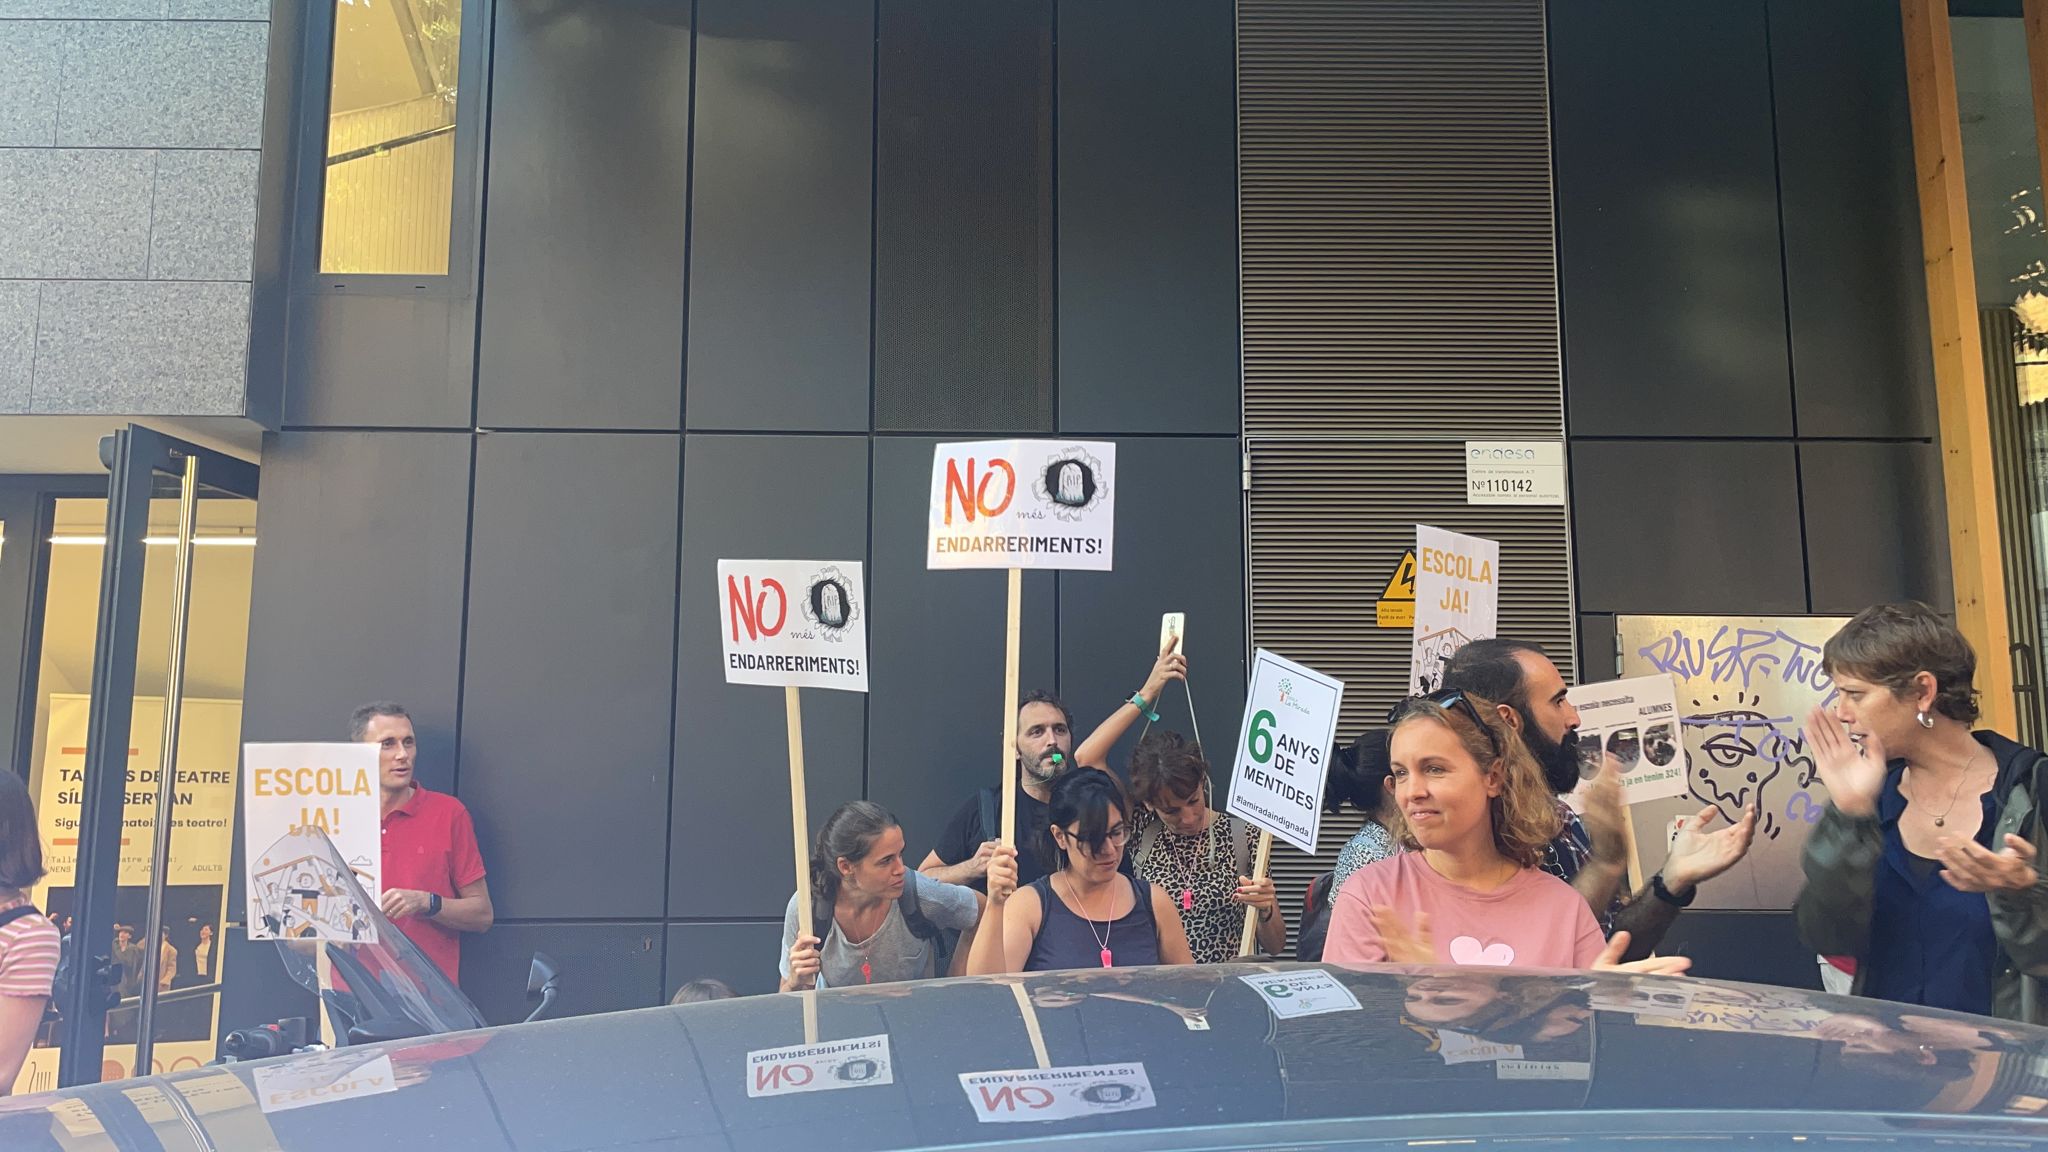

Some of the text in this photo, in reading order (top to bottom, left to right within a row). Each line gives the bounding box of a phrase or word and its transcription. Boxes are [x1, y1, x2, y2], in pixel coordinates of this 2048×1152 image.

[943, 457, 1047, 527] NO més
[937, 536, 1102, 555] ENDARRERIMENTS!
[1422, 546, 1493, 585] ESCOLA
[728, 574, 816, 643] NO més
[1440, 586, 1469, 614] JA!
[729, 653, 860, 676] ENDARRERIMENTS!
[1638, 702, 1673, 716] ALUMNES
[1248, 709, 1320, 765] 6 ANYS
[176, 771, 231, 784] EATRE
[1274, 753, 1296, 777] DE
[254, 767, 372, 796] ESCOLA
[1244, 765, 1314, 810] MENTIDES
[186, 818, 227, 828] teatre!
[289, 807, 340, 837] JA!
[1236, 795, 1309, 837] #lamiradaindignada
